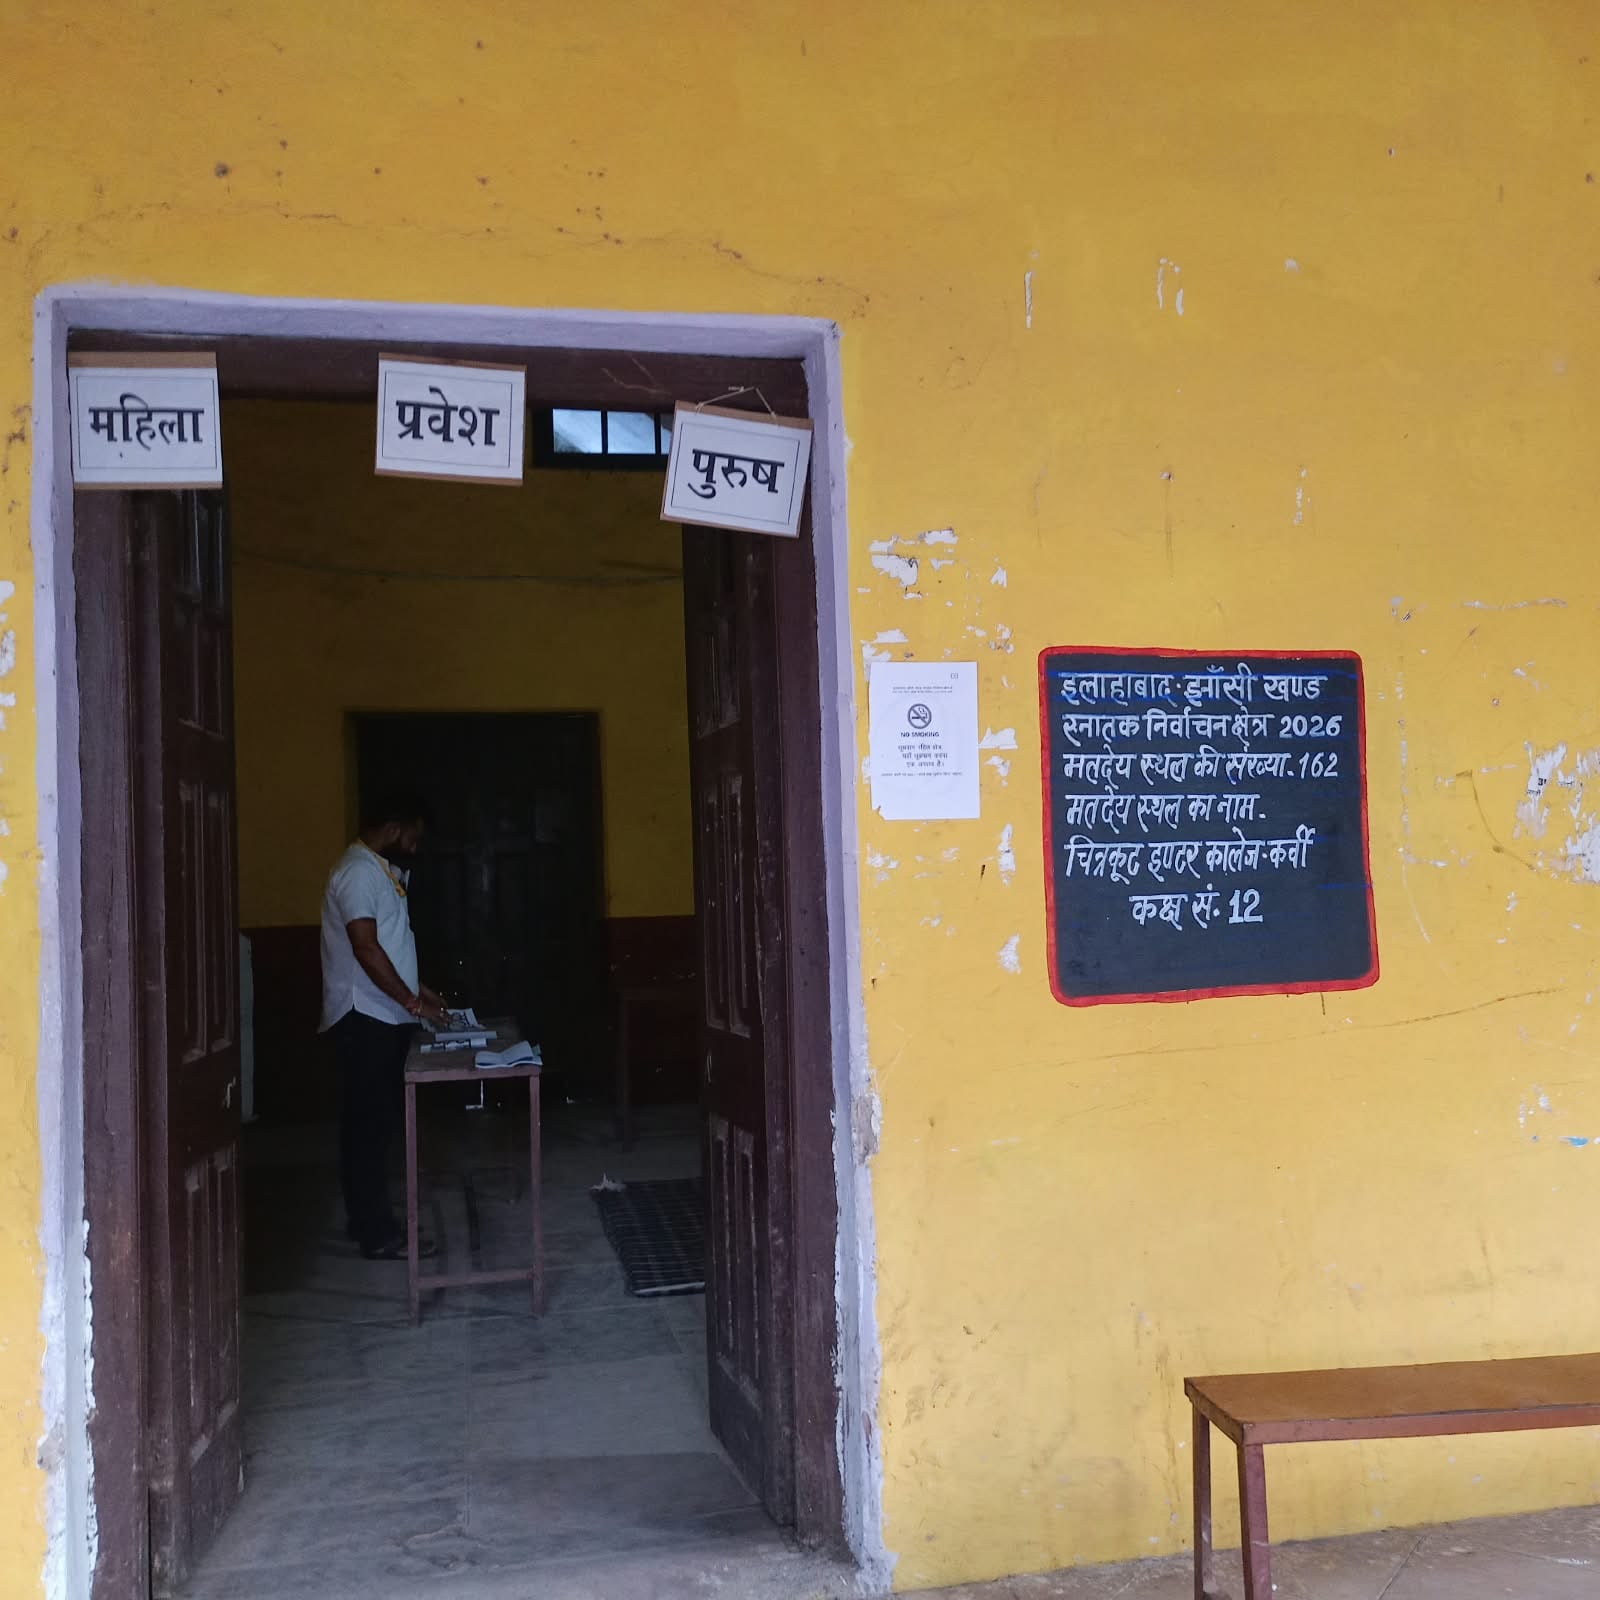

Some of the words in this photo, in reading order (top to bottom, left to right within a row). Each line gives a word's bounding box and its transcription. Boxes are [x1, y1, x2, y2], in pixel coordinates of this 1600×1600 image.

[89, 393, 205, 452] महिला
[395, 386, 500, 448] प्रवेश
[692, 447, 786, 499] पुरुष
[1263, 675, 1328, 703] खण्ड
[1062, 714, 1140, 746] स्नातक
[1279, 715, 1343, 739] 2026
[1194, 744, 1226, 777] की
[1298, 751, 1338, 779] 162
[1187, 794, 1217, 822] का
[1064, 834, 1144, 885] चित्रकूट
[1147, 841, 1203, 882] इण्टर
[1129, 893, 1188, 931] कक्ष
[1229, 889, 1263, 924] 12
